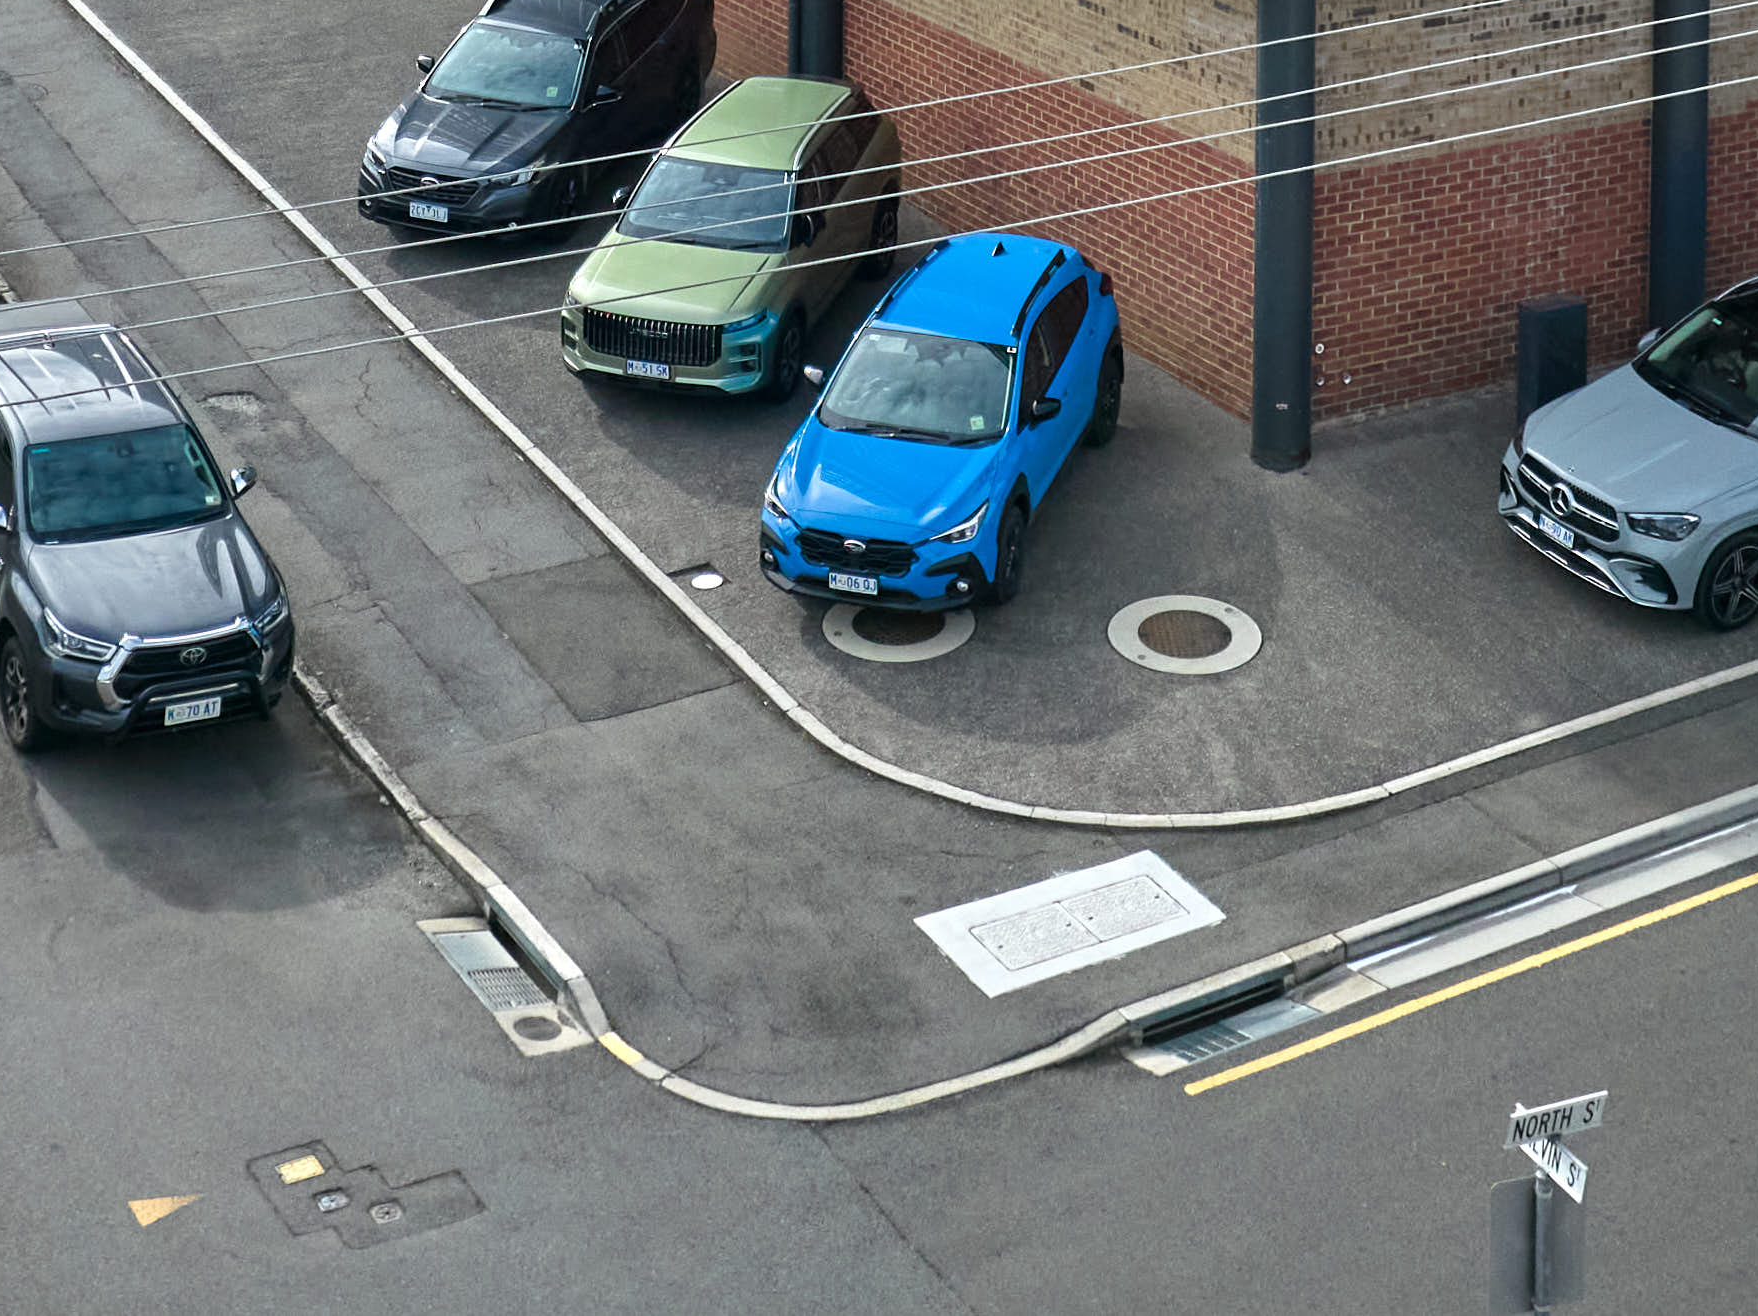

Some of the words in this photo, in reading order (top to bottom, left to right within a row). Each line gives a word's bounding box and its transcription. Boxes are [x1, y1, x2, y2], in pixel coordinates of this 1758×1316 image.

[847, 576, 860, 589] 06
[187, 704, 200, 718] 70
[204, 701, 220, 715] AT
[1512, 1106, 1574, 1142] NORTH
